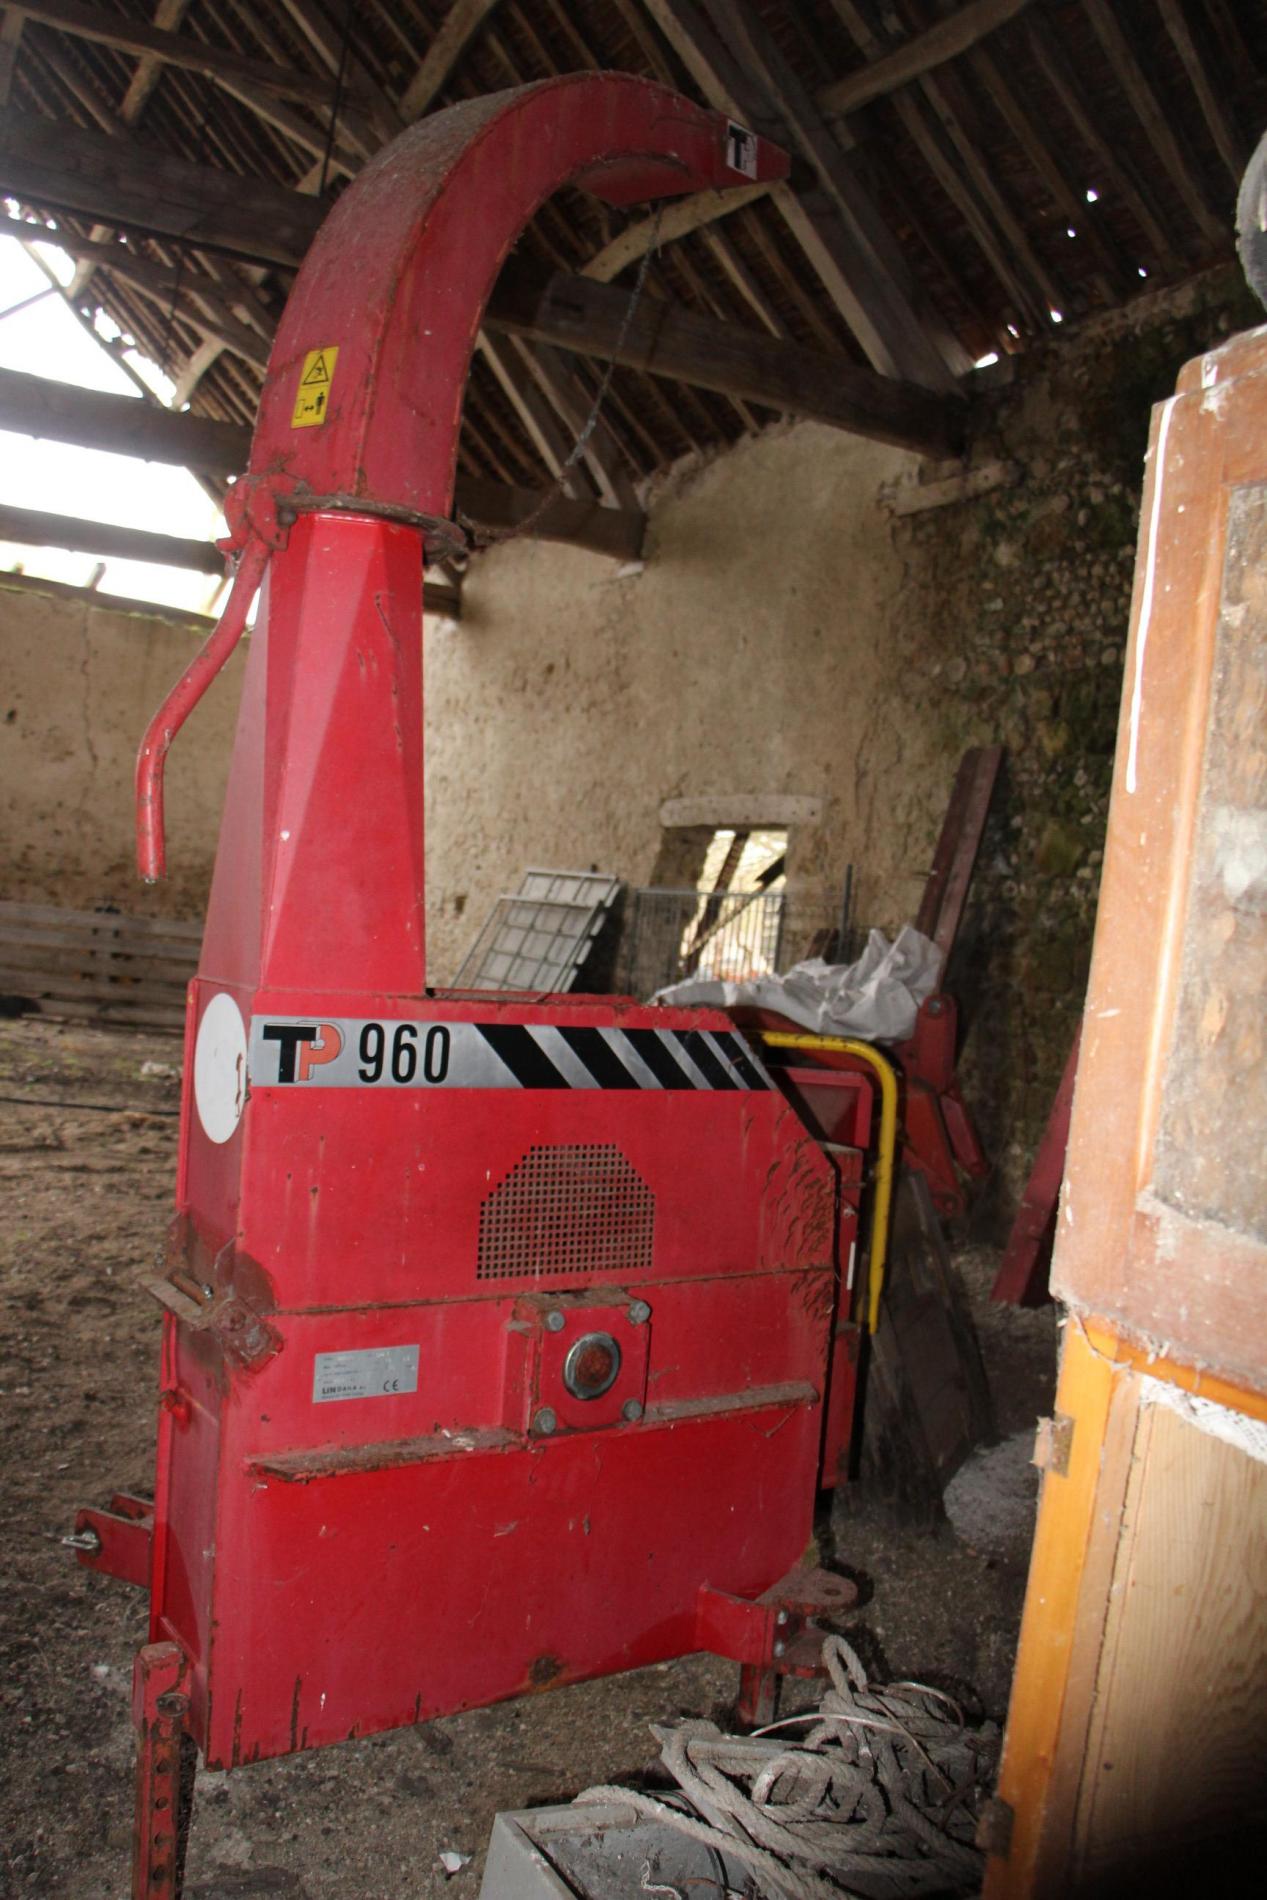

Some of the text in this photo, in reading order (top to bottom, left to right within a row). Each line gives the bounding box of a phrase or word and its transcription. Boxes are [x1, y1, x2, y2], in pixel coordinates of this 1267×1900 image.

[263, 1021, 450, 1084] TP 960
[383, 1379, 399, 1392] CE
